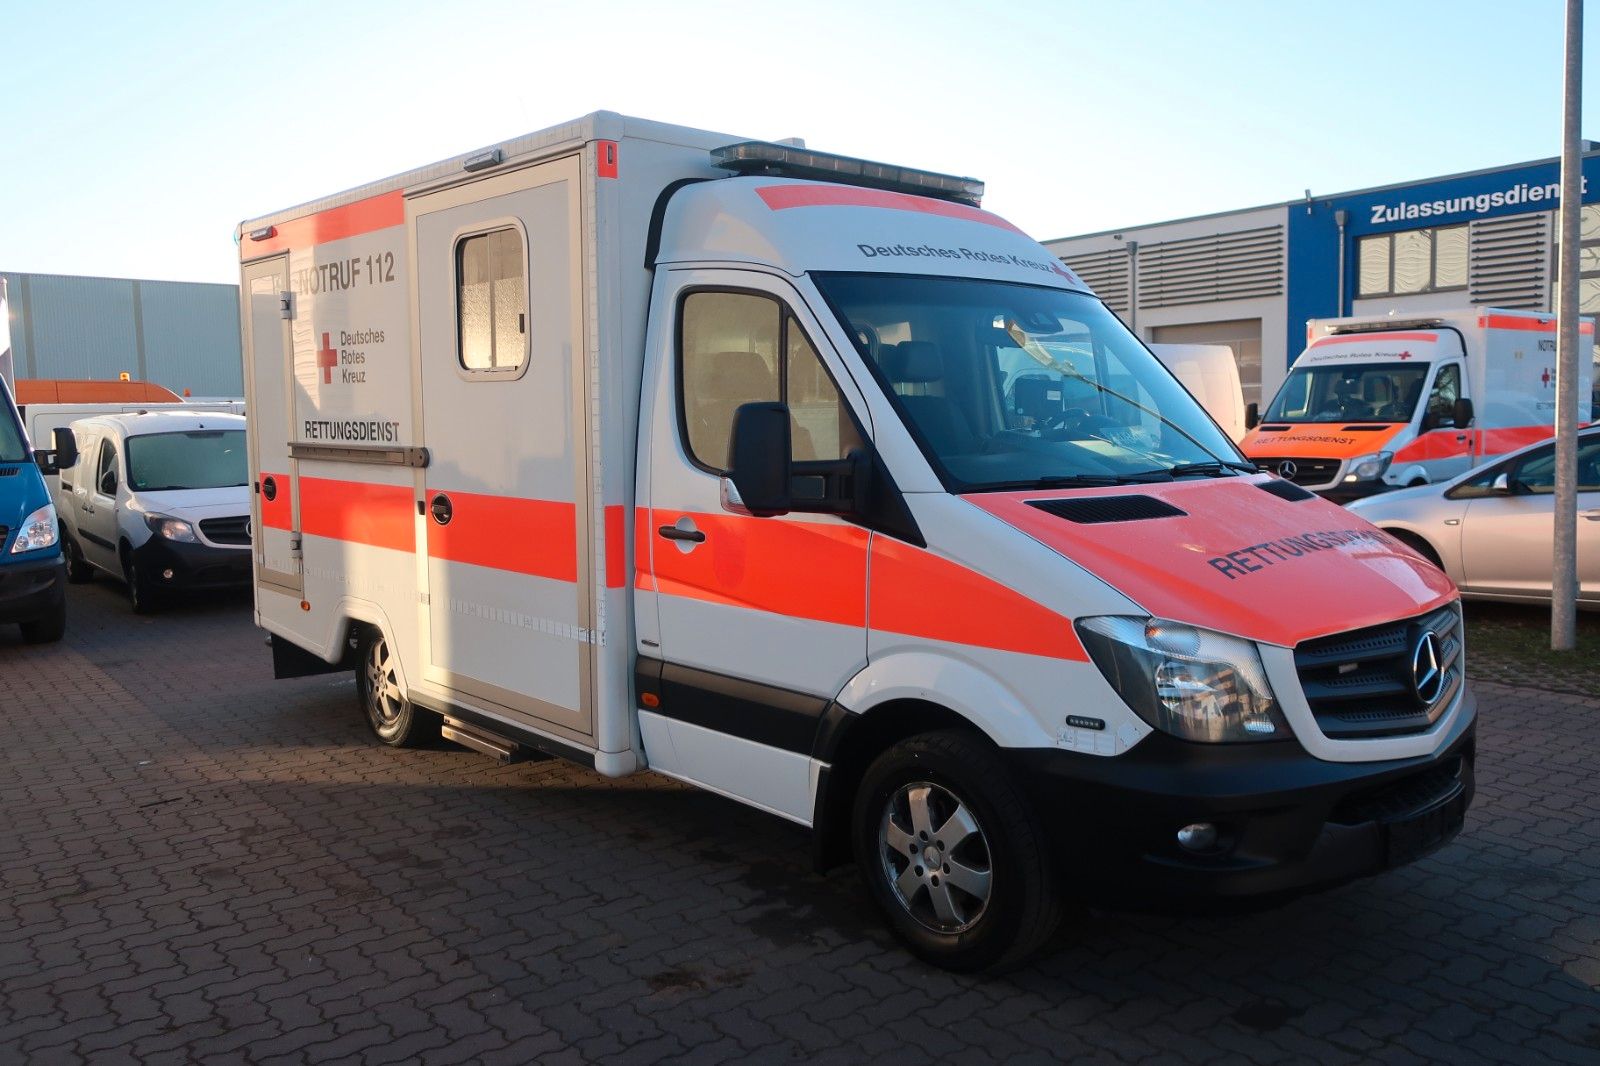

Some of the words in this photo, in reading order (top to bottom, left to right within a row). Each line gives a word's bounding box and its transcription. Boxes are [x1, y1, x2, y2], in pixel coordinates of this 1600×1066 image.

[1370, 175, 1588, 224] Zulassungsdient
[856, 243, 962, 259] Deutsches
[959, 247, 1010, 265] Rotes
[1008, 254, 1054, 273] Kreuz
[298, 257, 361, 296] NOTRUF
[366, 251, 395, 285] 112
[340, 328, 385, 347] Deutsches
[341, 349, 366, 365] Rotes
[342, 368, 367, 384] Kreuz
[304, 420, 400, 442] RETTUNGSDIENST
[1254, 435, 1357, 446] RETTUNGSDIENST
[1206, 529, 1393, 580] RETTUNGS
